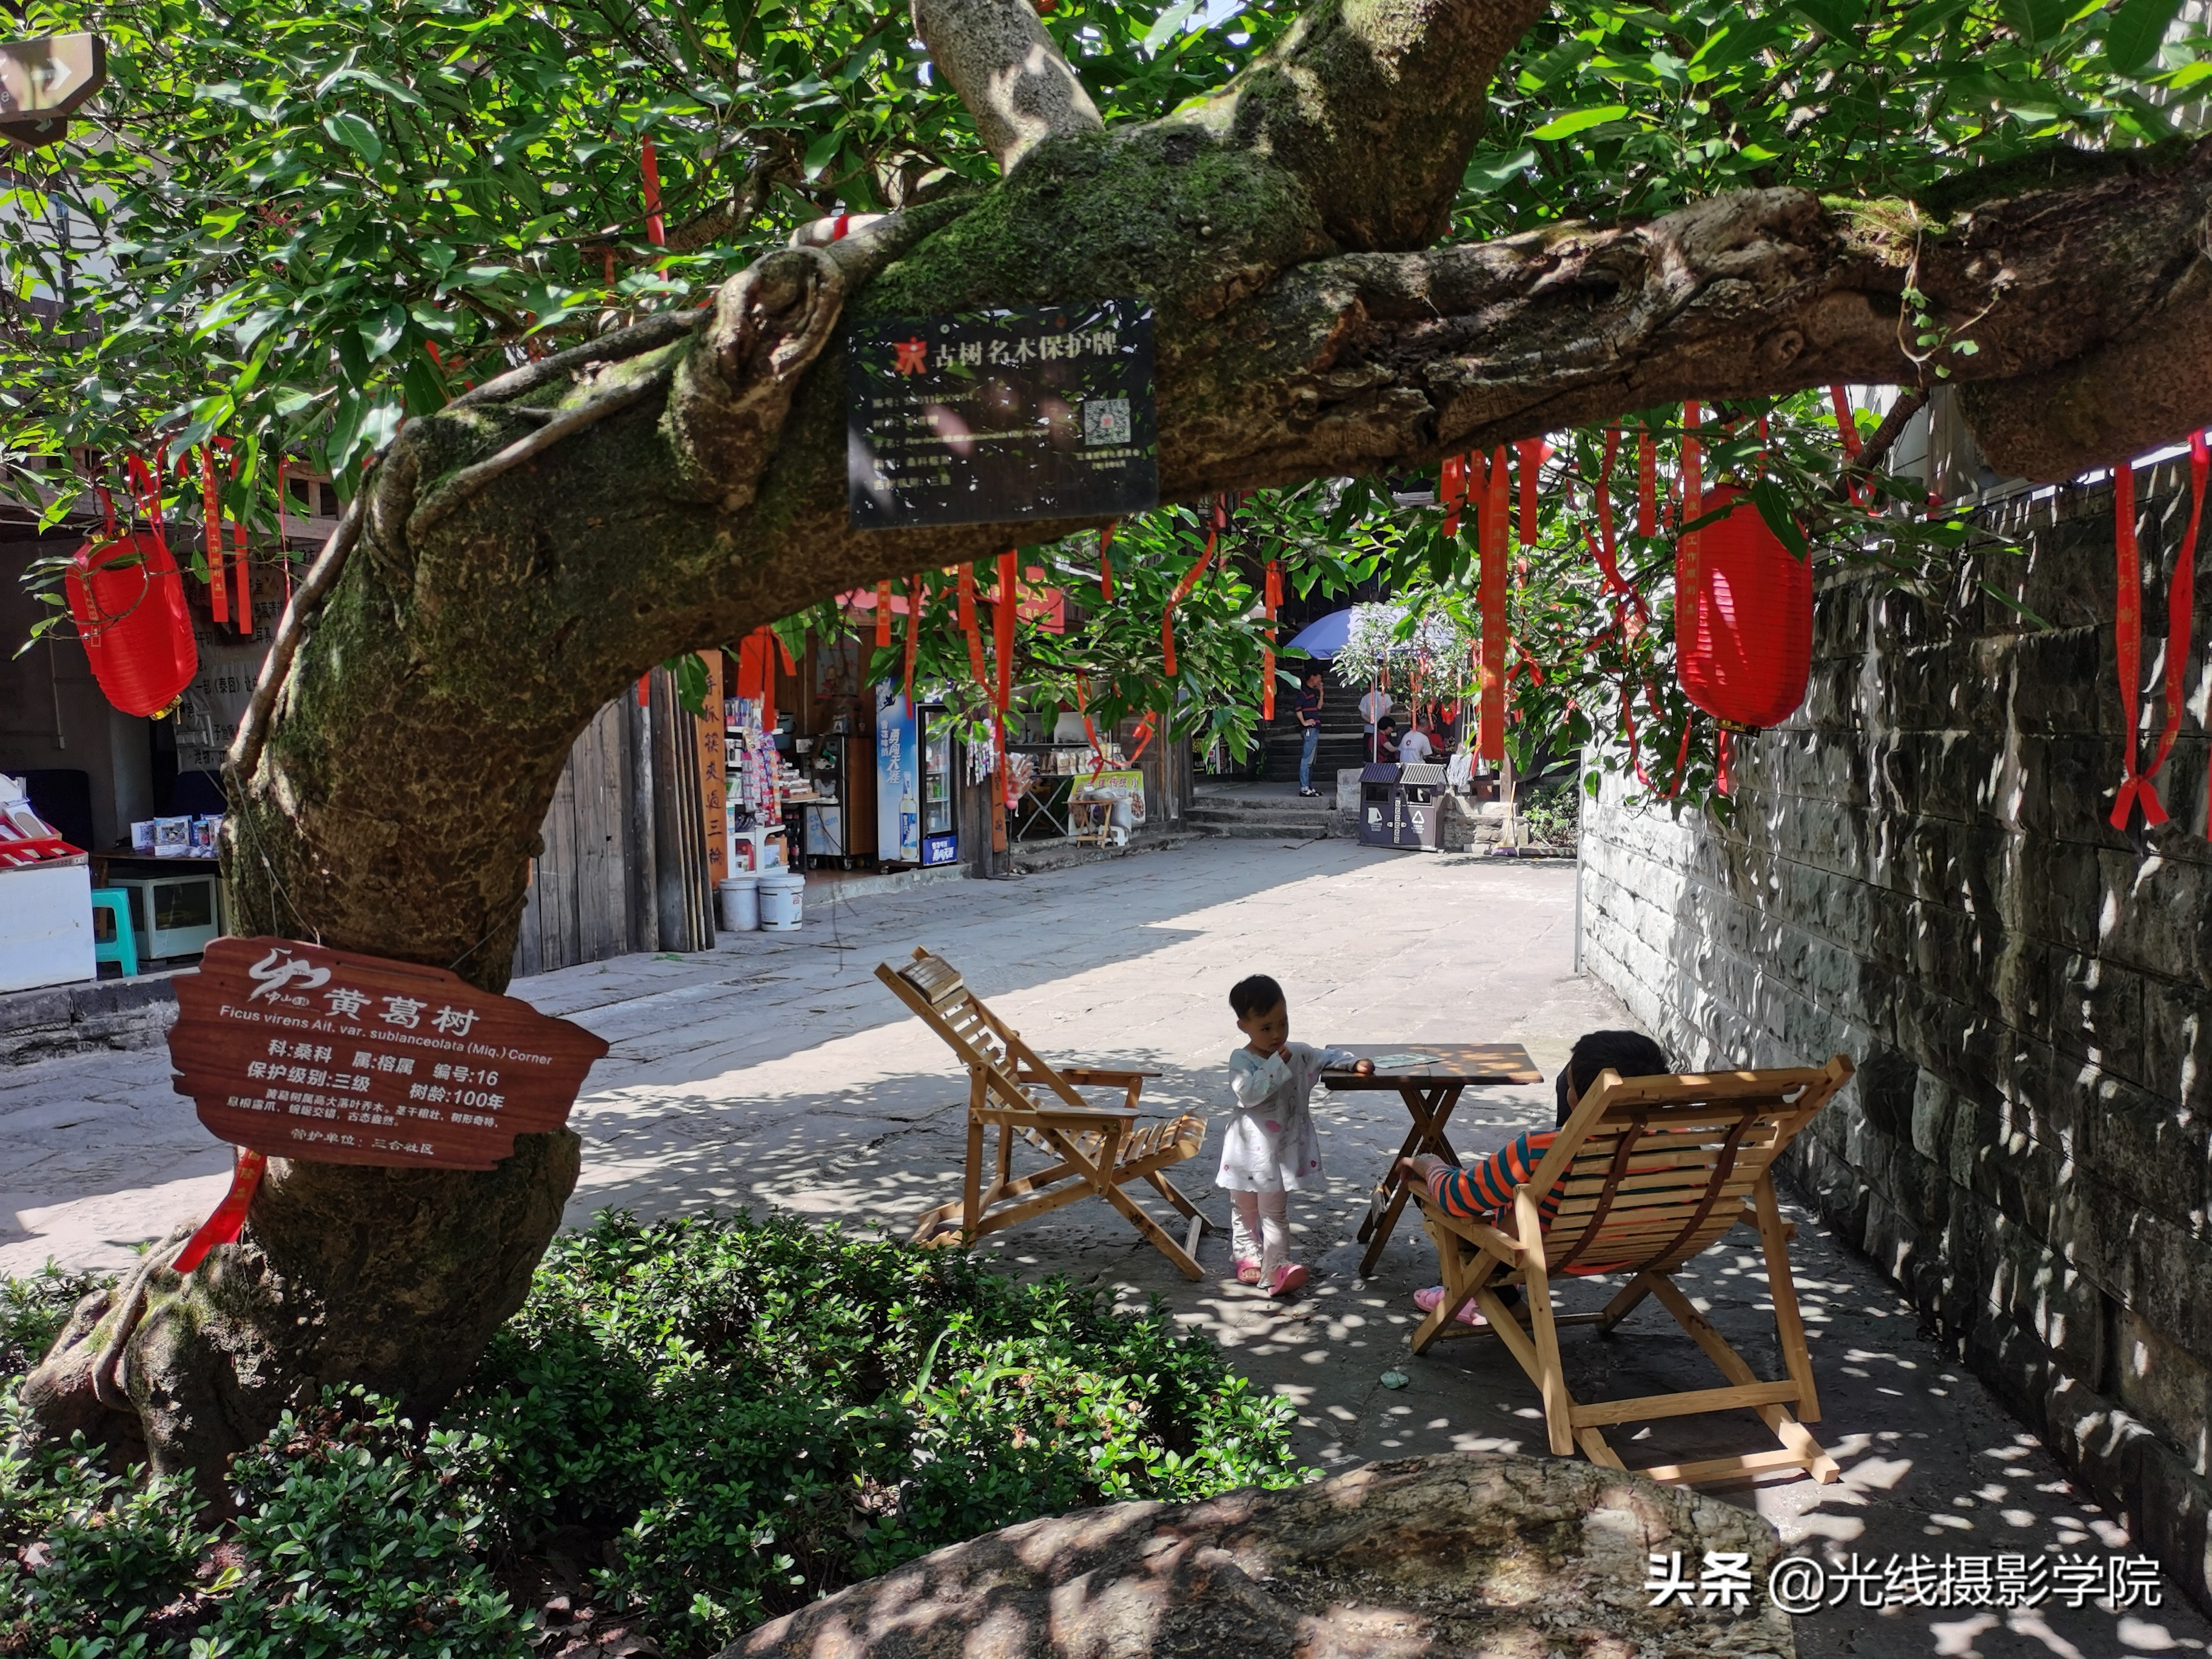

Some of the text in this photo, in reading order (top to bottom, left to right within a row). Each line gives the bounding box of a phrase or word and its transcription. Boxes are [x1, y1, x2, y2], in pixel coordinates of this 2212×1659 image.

[936, 331, 1117, 368] 古树名木保护牌
[886, 728, 901, 783] 勇闯天涯
[220, 1005, 260, 1022] Ficus
[264, 1013, 309, 1029] virens
[340, 1025, 366, 1037] var.
[370, 1030, 464, 1052] sublanceolata
[508, 1049, 553, 1065] Corner
[323, 988, 480, 1036] 黄葛树
[247, 1061, 506, 1110] 保护级别:三级 树龄:100年
[268, 1039, 499, 1087] 科:桑科 属:榕属 编号:16
